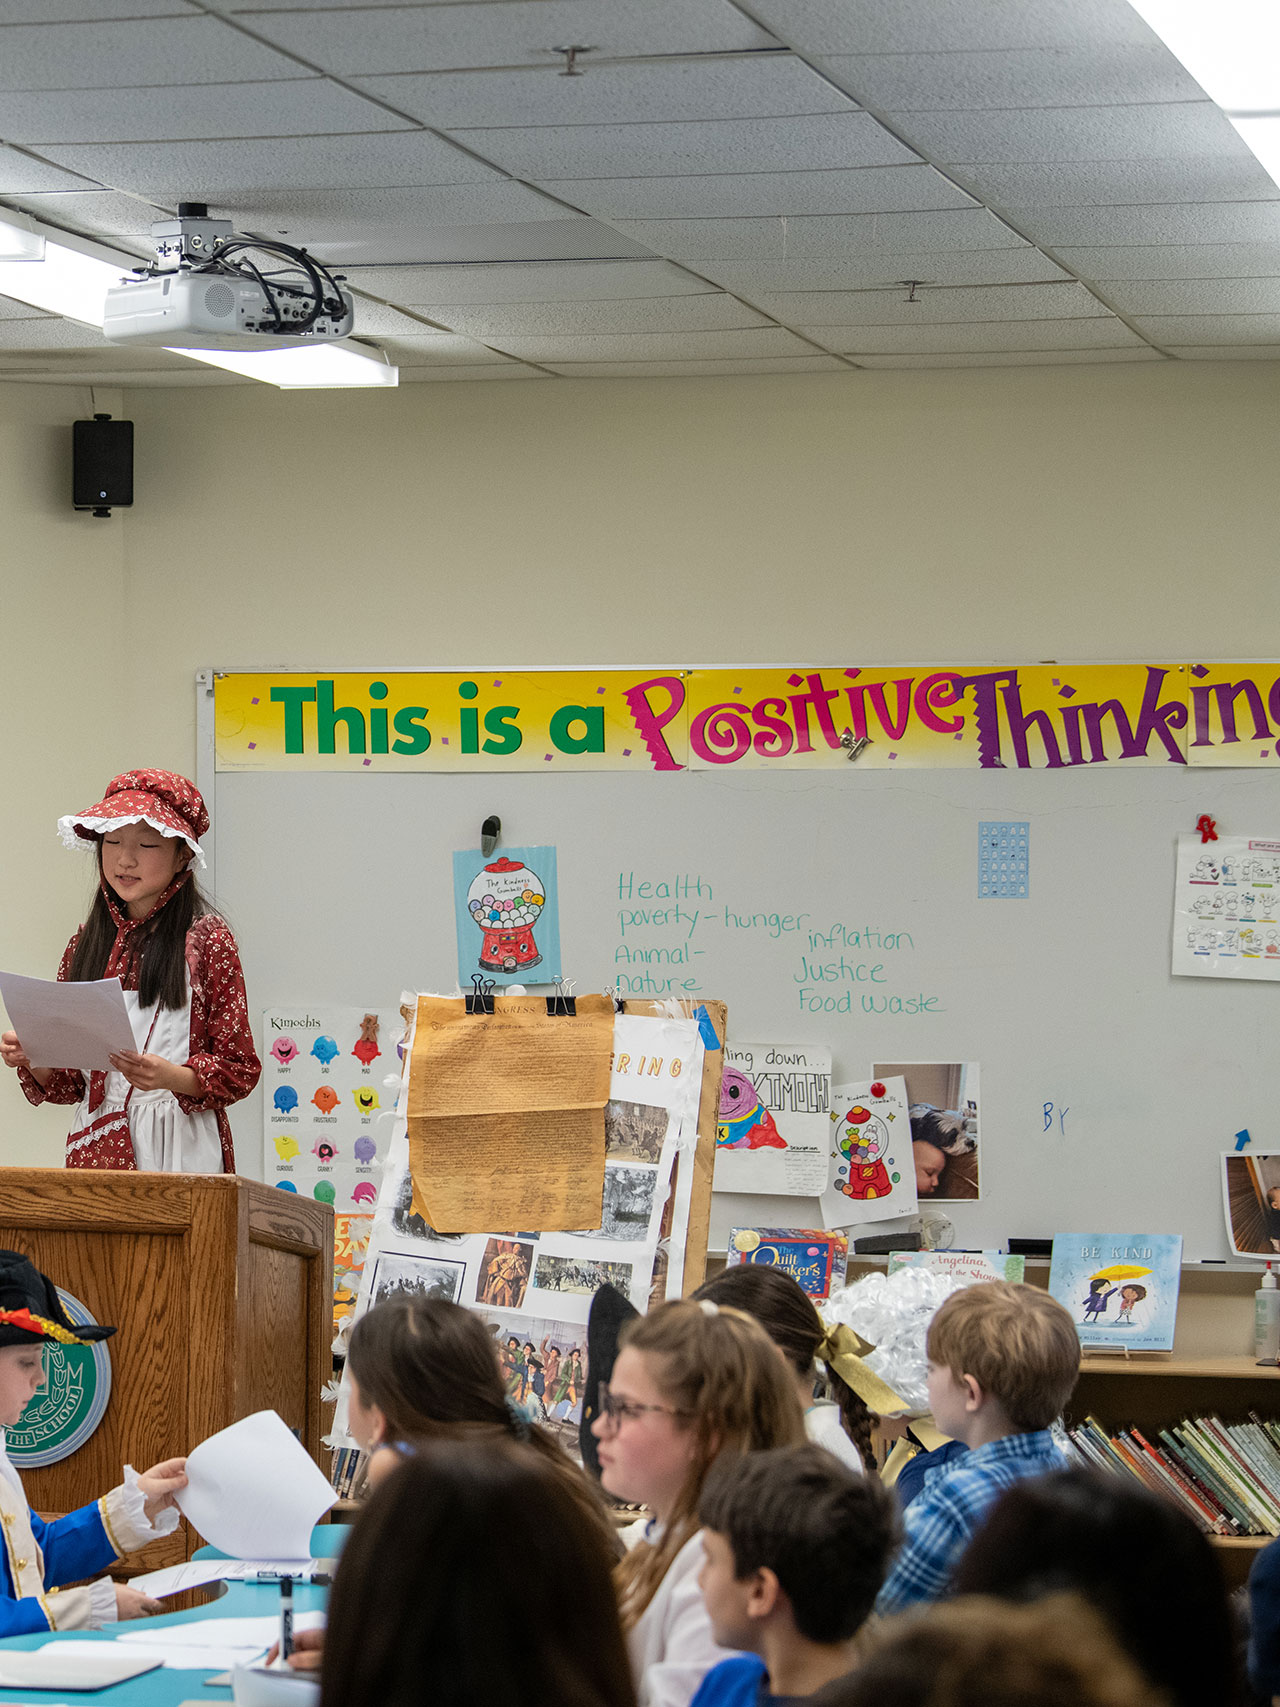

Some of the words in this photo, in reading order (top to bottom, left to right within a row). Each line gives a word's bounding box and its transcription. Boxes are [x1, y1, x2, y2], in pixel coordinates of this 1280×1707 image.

[270, 680, 431, 756] This
[459, 681, 522, 755] is
[549, 705, 606, 755] a
[622, 676, 965, 771] Positive
[486, 879, 499, 889] The
[504, 878, 530, 886] Kindness
[618, 872, 713, 900] Health
[809, 923, 914, 953] inflation
[616, 970, 703, 994] nature
[793, 956, 888, 983] Justice
[495, 1006, 535, 1014] NGRESS
[799, 988, 852, 1014] Food
[862, 993, 947, 1014] waste
[270, 1015, 321, 1030] Kimochis
[1043, 1102, 1069, 1136] BY
[751, 1246, 797, 1267] Quilt
[778, 1246, 794, 1254] The
[1080, 1247, 1101, 1258] BE
[1111, 1247, 1153, 1259] KIND
[9, 1433, 33, 1444] THE
[35, 1390, 81, 1439] SCHOOL
